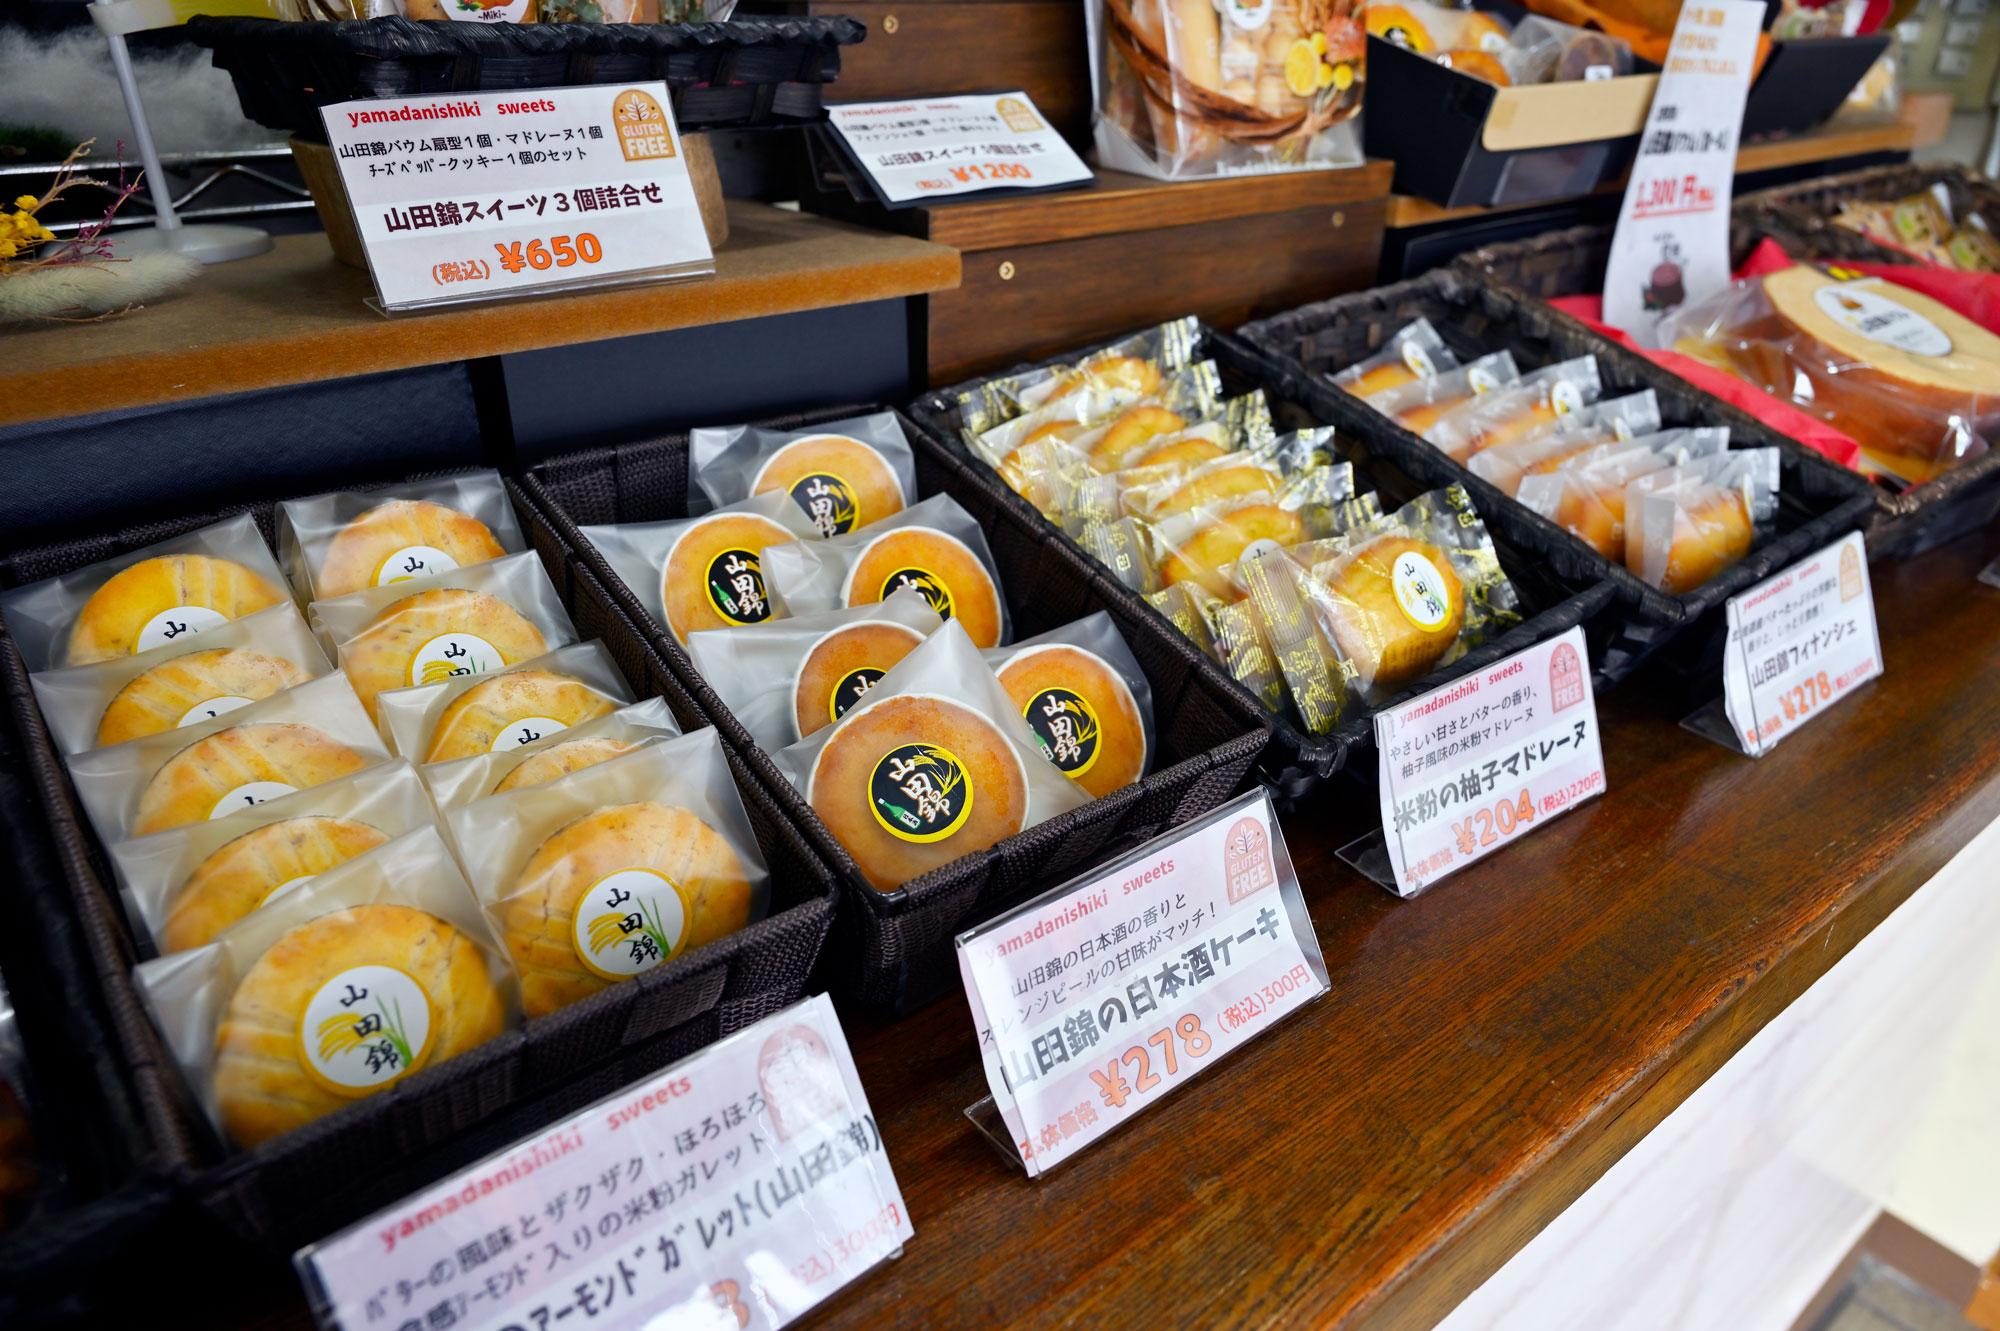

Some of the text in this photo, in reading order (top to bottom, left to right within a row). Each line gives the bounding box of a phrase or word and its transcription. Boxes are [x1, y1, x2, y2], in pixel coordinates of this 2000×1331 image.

[347, 98, 556, 128] yamadanishiki sweets
[621, 122, 665, 137] GLUTEN
[625, 135, 670, 158] FREE
[383, 182, 664, 233] 山田錦スイーツ3個詰合せ
[948, 162, 1033, 184] ¥1200
[432, 232, 603, 286] (税込) ¥650
[723, 554, 764, 616] 山田錦
[1751, 619, 1858, 689] 山田錦フィナンシェ
[1042, 694, 1081, 763] 山田錦
[1400, 677, 1480, 729] yamadanishiki
[1487, 659, 1524, 686] sweets
[1777, 670, 1834, 721] ¥278
[1393, 720, 1587, 834] 米粉の柚子マドレーヌ
[1401, 706, 1535, 780] 柚子風味の米粉マドレーヌ
[888, 757, 951, 824] 山田錦
[1450, 787, 1536, 856] ¥204
[1230, 848, 1266, 877] GLUTEN
[1231, 865, 1270, 899] FREE
[606, 887, 658, 965] 山田錦
[985, 857, 1176, 967] yamadanishiki sweets
[1010, 891, 1188, 998] 山田錦の日本酒の香りと
[339, 985, 399, 1075] 山田錦
[1000, 906, 1281, 1096] 山田錦の日本酒ケーキ
[1088, 1012, 1213, 1109] ¥278
[1215, 963, 1312, 1036] (税込)300円
[378, 1125, 584, 1255] yamadanishiki
[606, 1075, 693, 1132] sweets
[499, 1113, 880, 1331] アーモンドガレット(山田錦)
